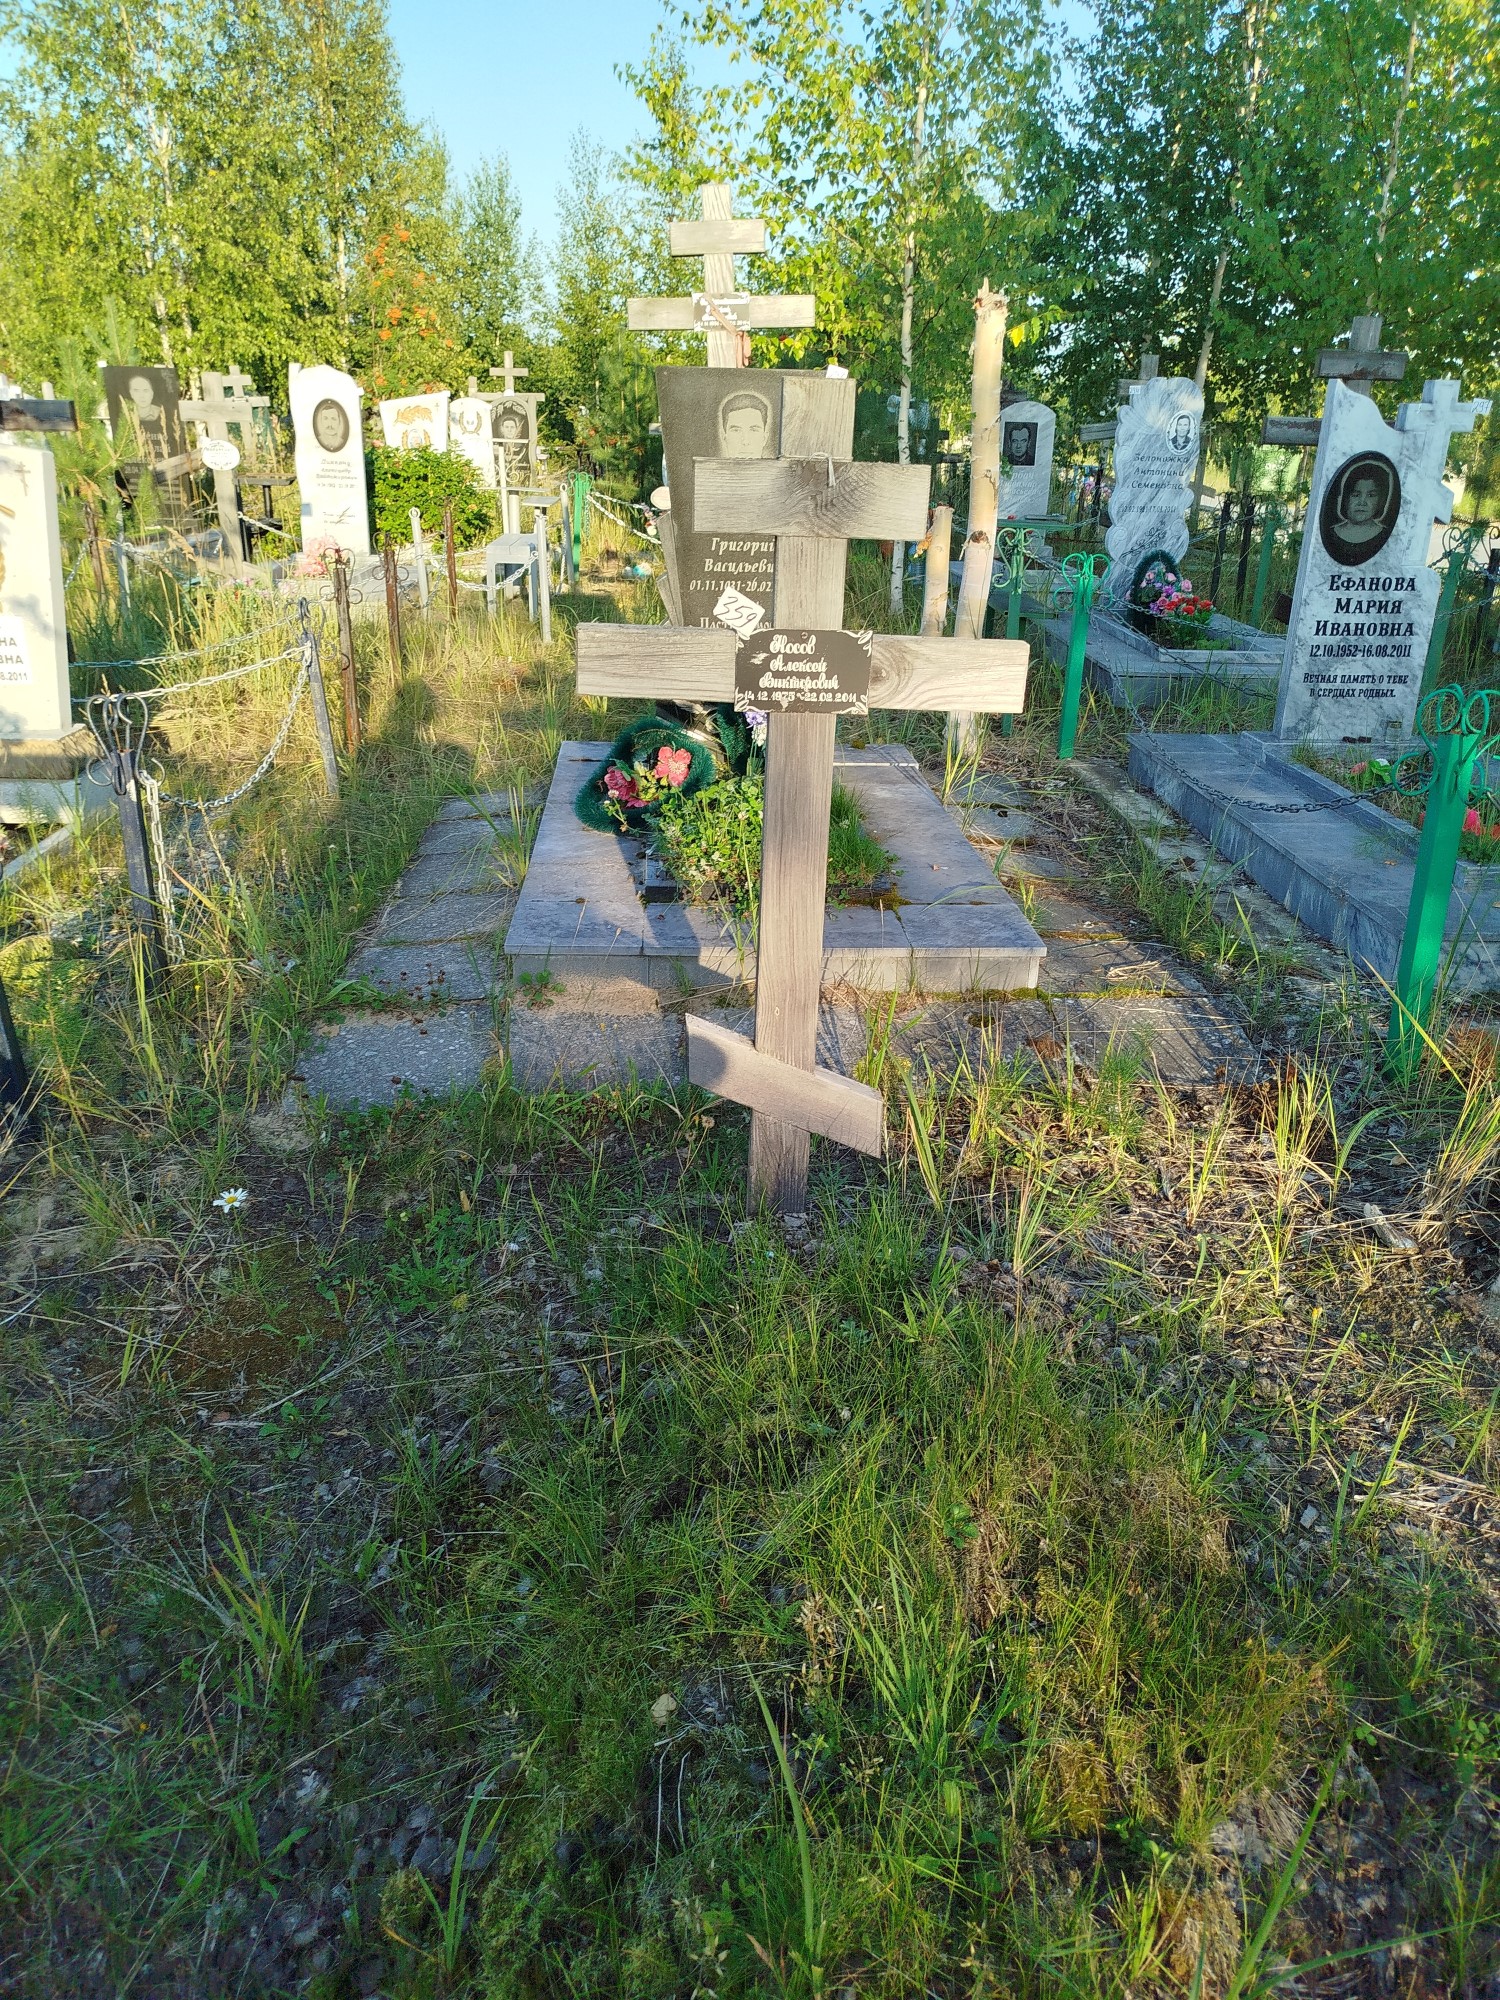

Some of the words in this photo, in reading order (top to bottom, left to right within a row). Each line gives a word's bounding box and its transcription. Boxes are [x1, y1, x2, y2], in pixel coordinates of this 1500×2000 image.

[1333, 597, 1404, 614] МАРИЯ
[1313, 620, 1415, 637] ИВАНОВНА
[769, 634, 817, 655] Носов
[1309, 644, 1412, 658] 12.10.1952-16.08.2011
[769, 654, 828, 673] Алексей
[758, 671, 840, 692] Викторович
